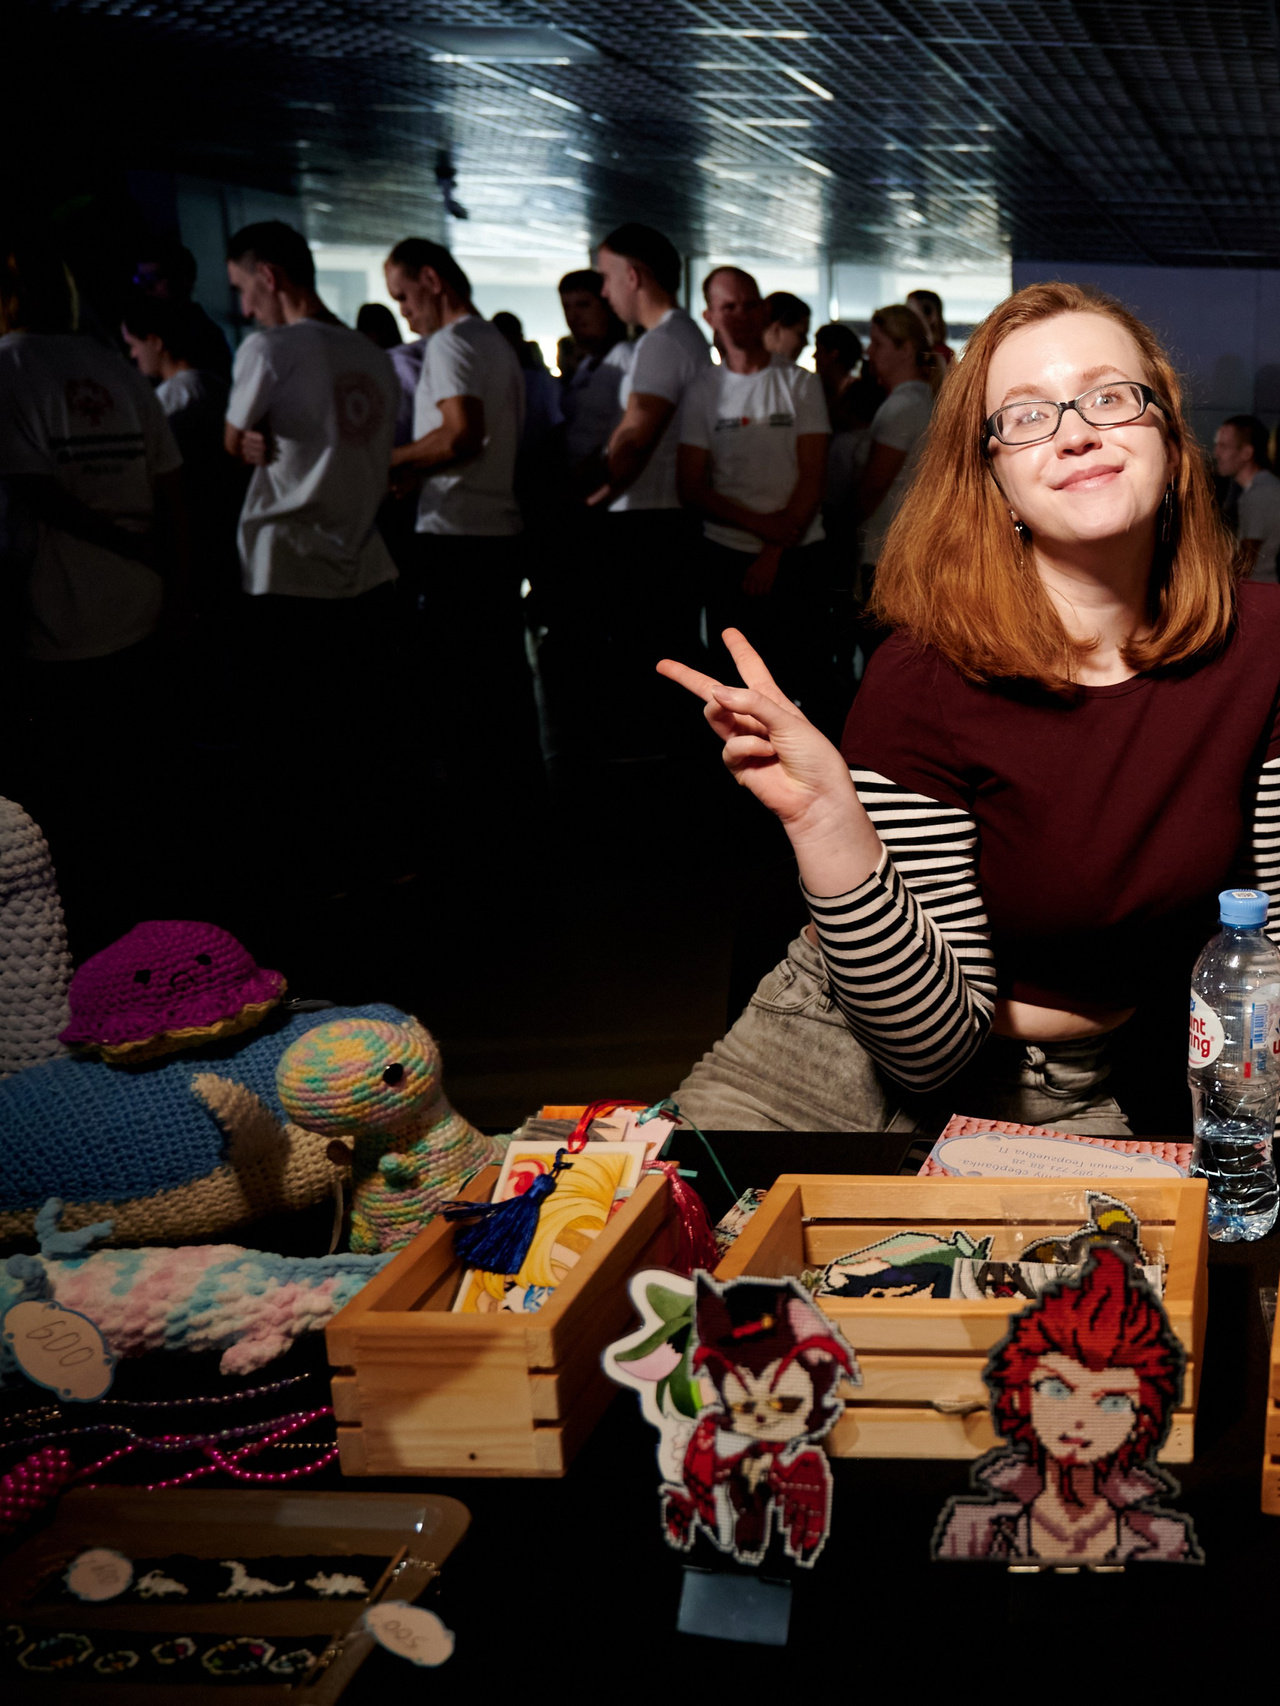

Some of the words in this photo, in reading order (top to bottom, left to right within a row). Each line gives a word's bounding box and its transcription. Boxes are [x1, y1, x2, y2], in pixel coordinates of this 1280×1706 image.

[1190, 1015, 1206, 1036] int
[1189, 1031, 1211, 1058] ing
[1015, 1149, 1084, 1168] Георгиевна
[1030, 1162, 1045, 1170] 88
[1090, 1162, 1134, 1173] Ксения
[1050, 1165, 1069, 1173] 721
[1072, 1168, 1094, 1177] 987
[26, 1320, 95, 1368] 600
[383, 1620, 431, 1649] 500
